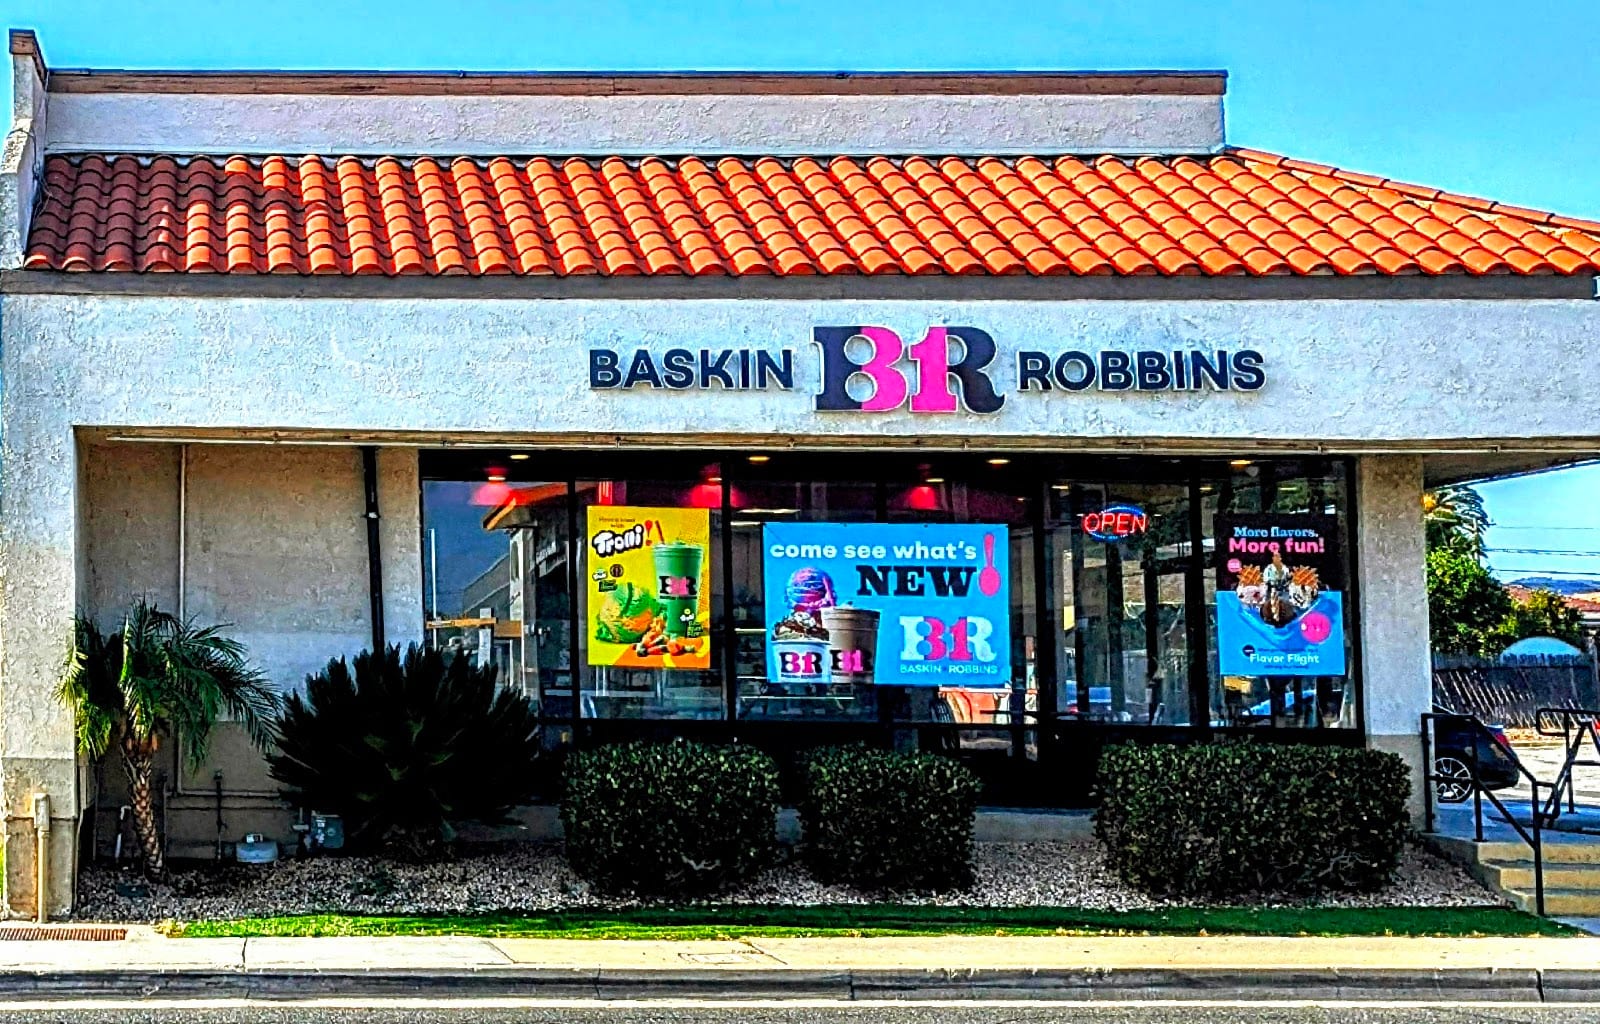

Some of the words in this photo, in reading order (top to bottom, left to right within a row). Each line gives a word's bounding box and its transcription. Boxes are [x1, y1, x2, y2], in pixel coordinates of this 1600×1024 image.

[589, 348, 794, 390] BASKIN
[1017, 350, 1267, 392] ROBBINS
[1084, 512, 1147, 534] OPEN
[1233, 526, 1269, 538] More
[1270, 526, 1319, 538] flavors.
[592, 524, 644, 558] Trolli
[771, 544, 837, 558] come
[844, 544, 887, 558] see
[893, 540, 977, 560] what's
[1229, 537, 1280, 553] More
[1285, 537, 1325, 553] fun!
[1250, 653, 1285, 663] Flavor
[1287, 653, 1320, 666] Flight
[900, 664, 942, 673] BASKIN
[948, 664, 998, 674] ROBBINS
